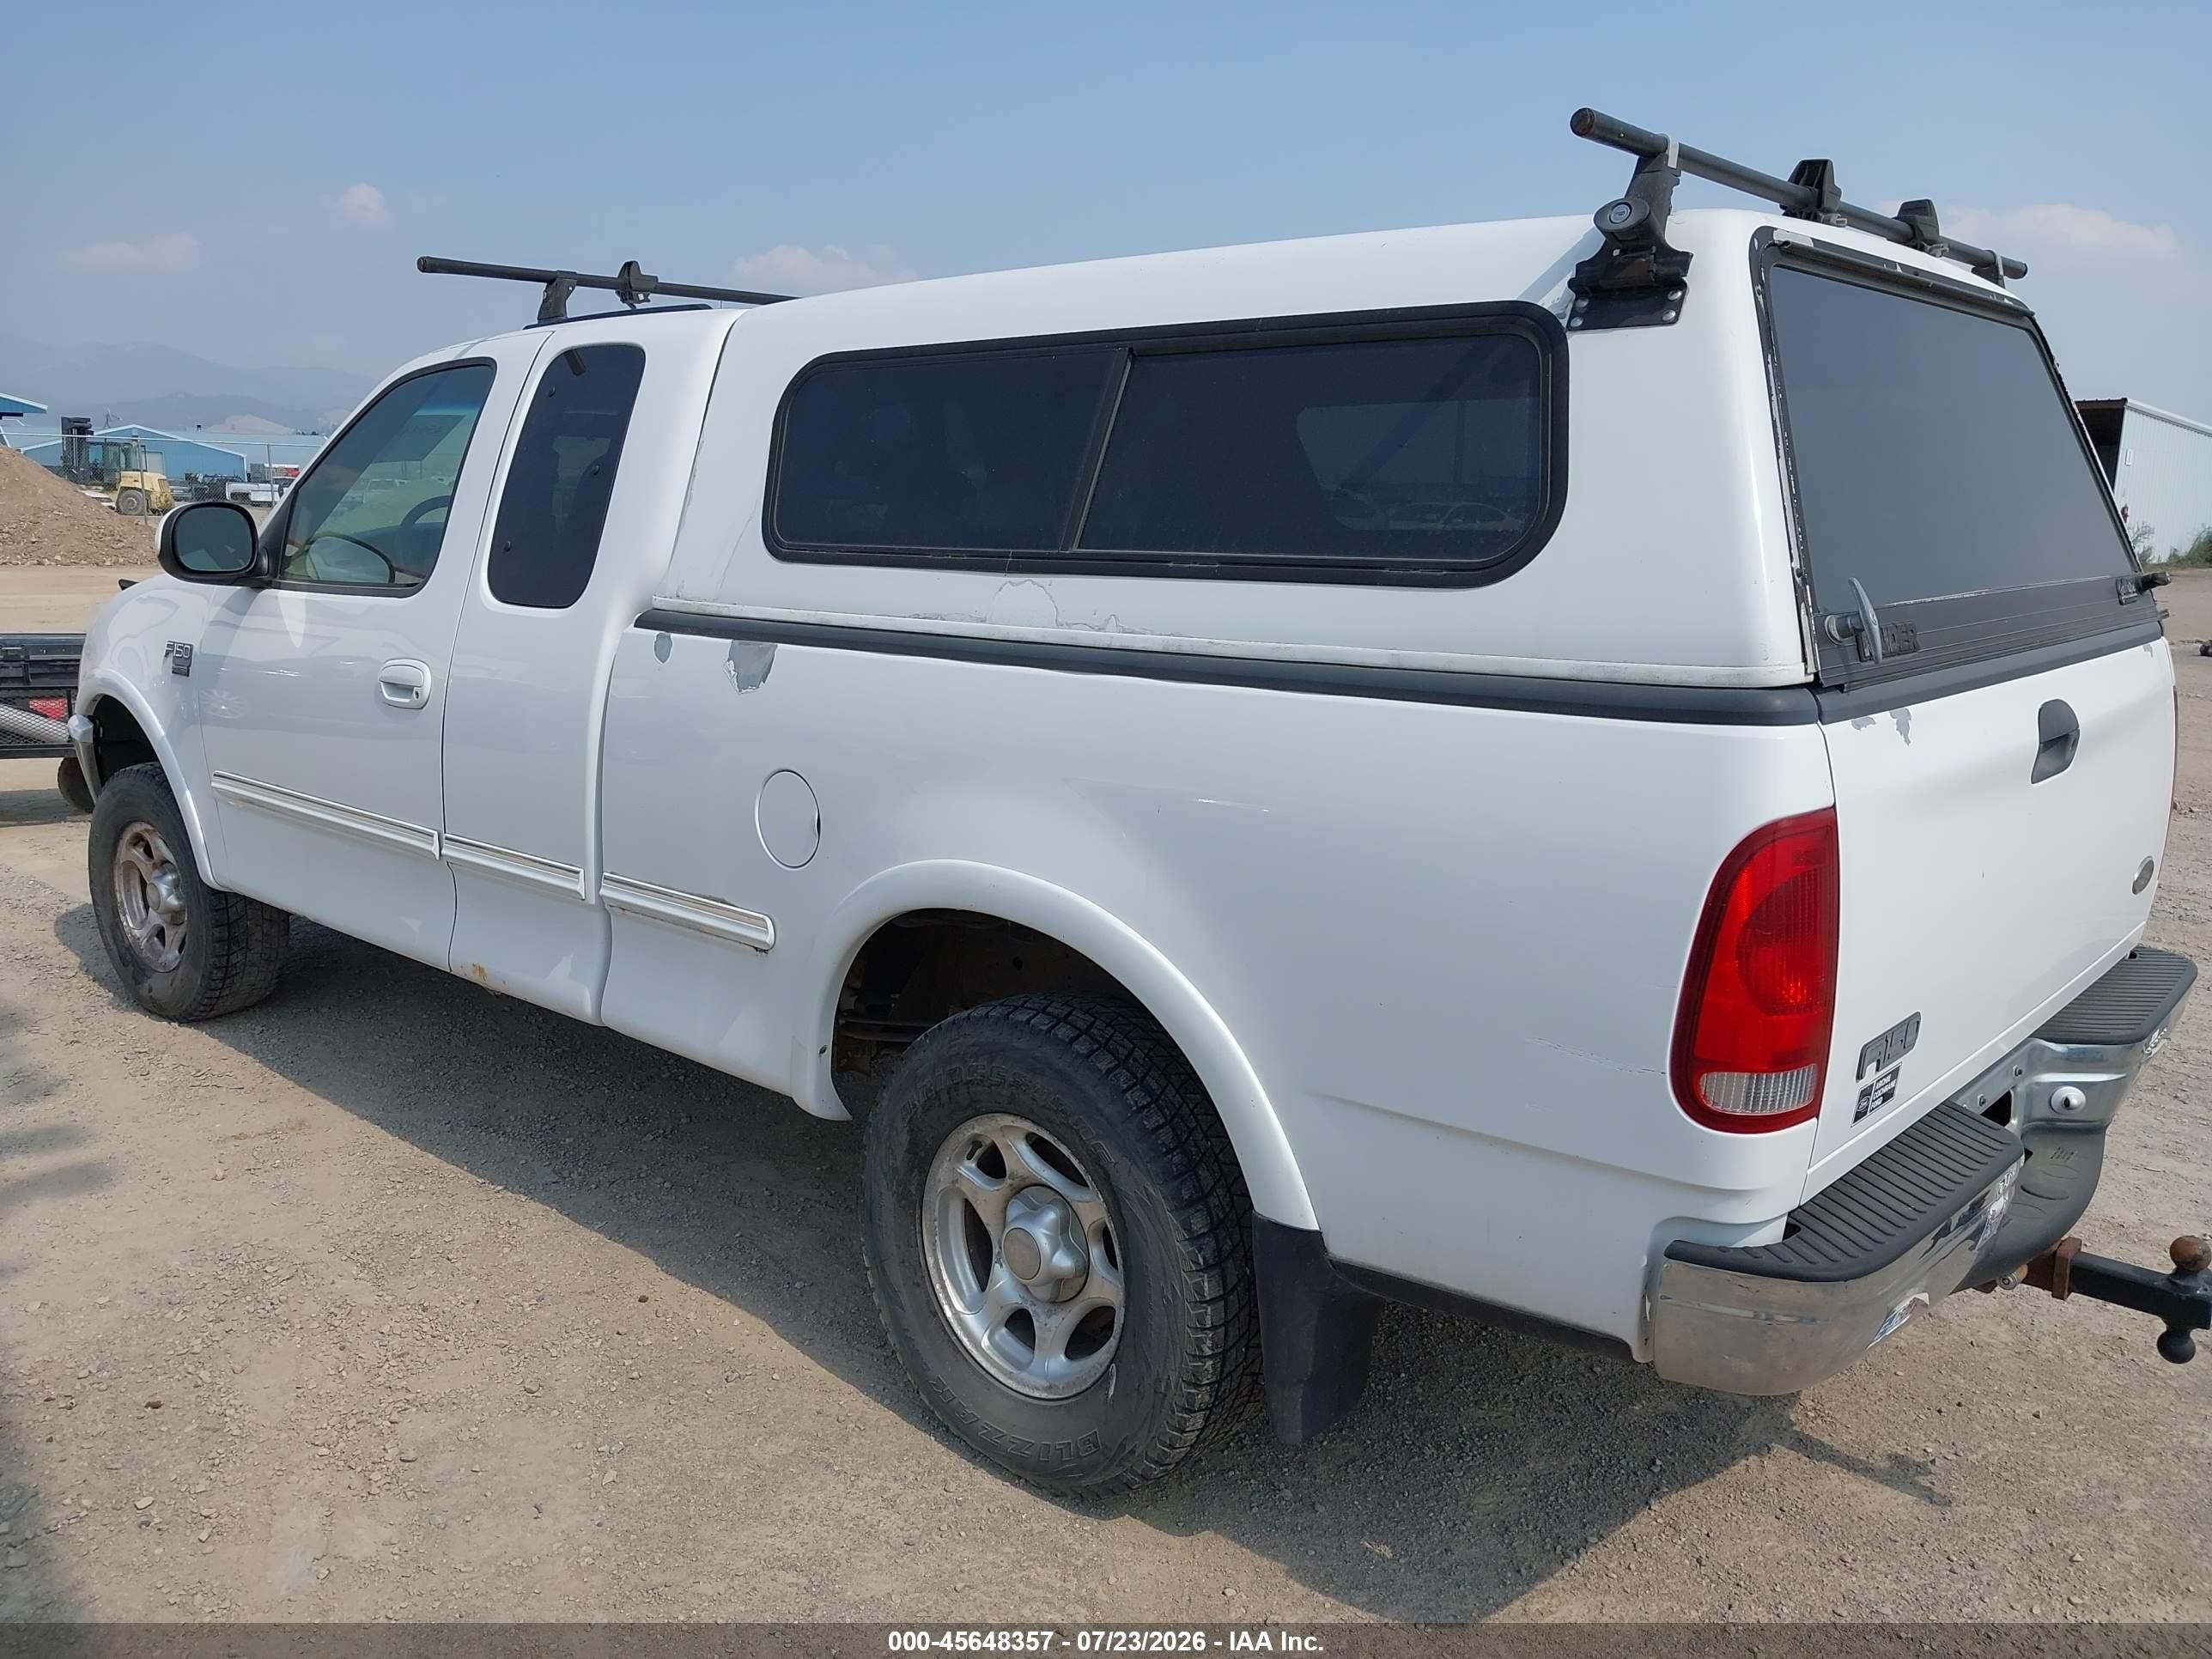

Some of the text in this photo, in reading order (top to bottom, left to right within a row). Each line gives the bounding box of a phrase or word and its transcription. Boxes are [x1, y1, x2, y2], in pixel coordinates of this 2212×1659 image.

[164, 641, 191, 659] F150
[1856, 1012, 1921, 1082] F150
[928, 1375, 1103, 1462] BLIZZAK
